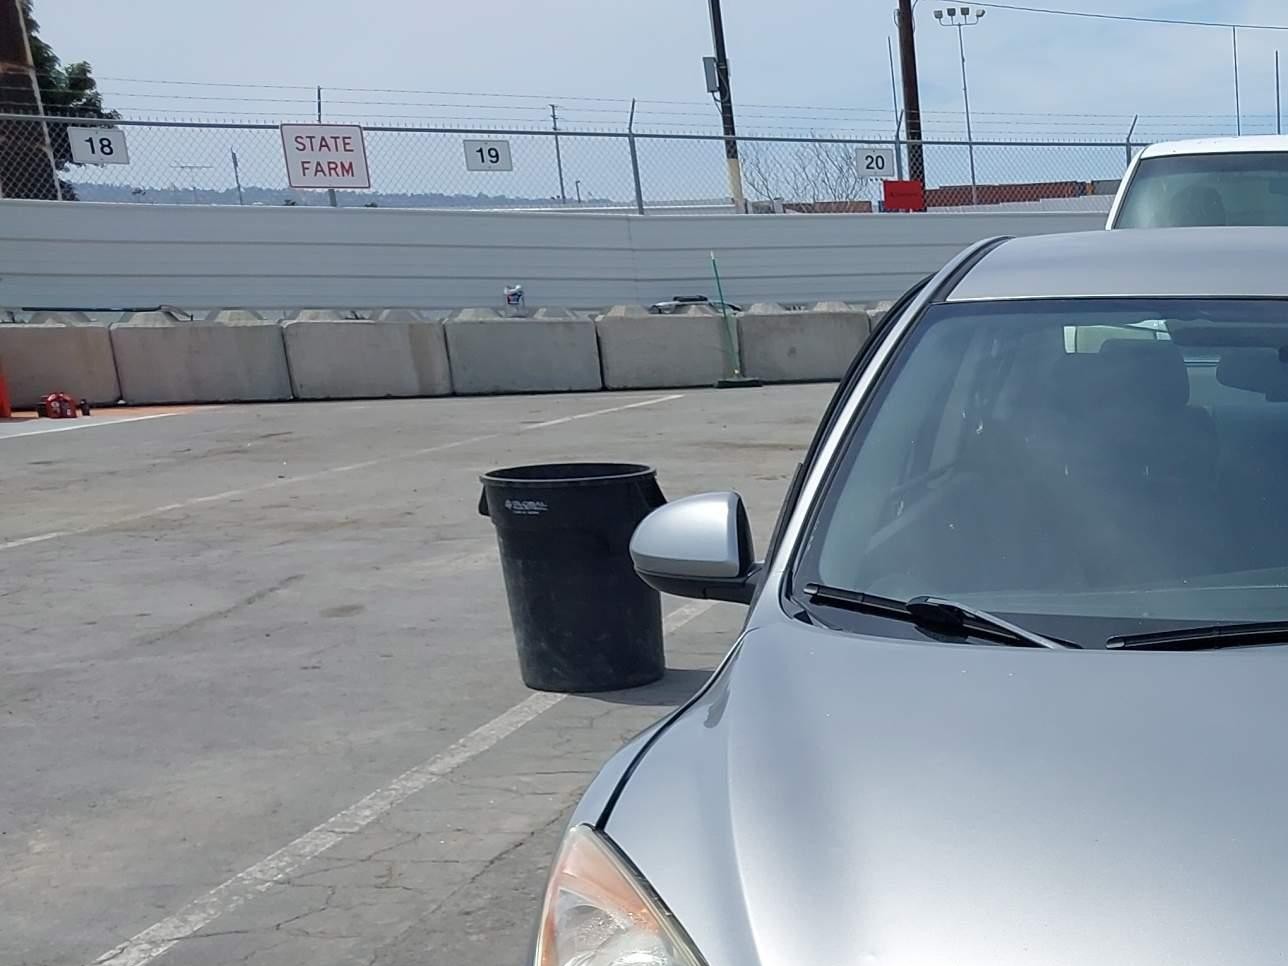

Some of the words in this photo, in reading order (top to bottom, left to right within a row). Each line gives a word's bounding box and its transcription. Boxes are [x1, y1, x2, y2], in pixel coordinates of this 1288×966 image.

[84, 136, 114, 156] 18
[294, 135, 354, 152] STATE
[475, 147, 499, 164] 19
[865, 154, 885, 170] 20
[301, 160, 355, 178] FARM
